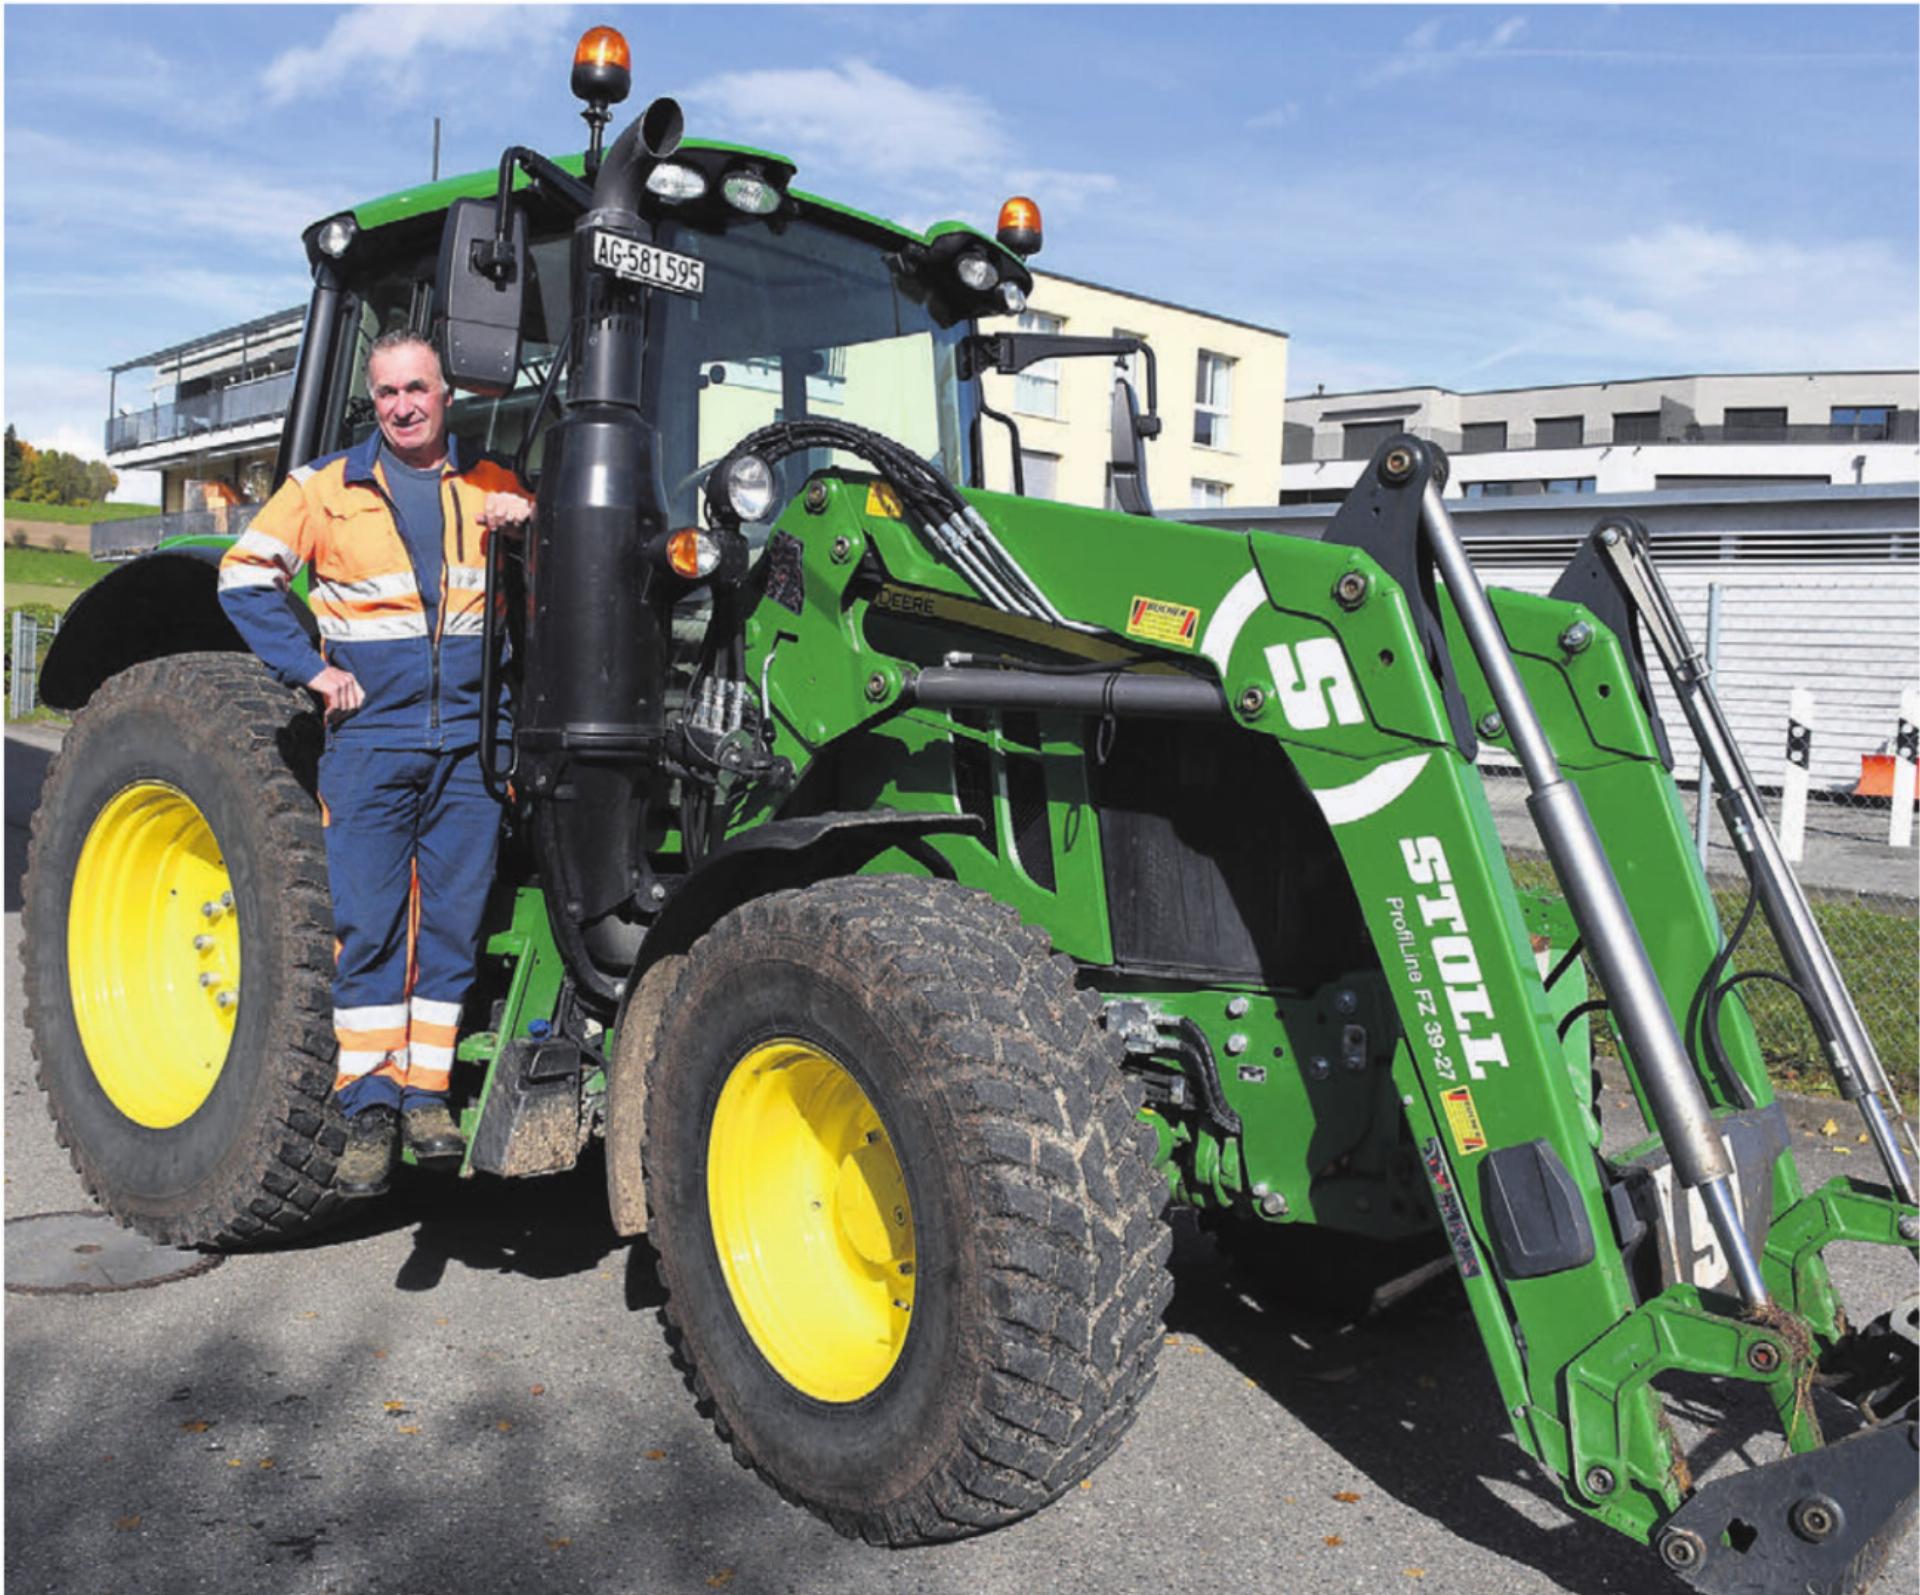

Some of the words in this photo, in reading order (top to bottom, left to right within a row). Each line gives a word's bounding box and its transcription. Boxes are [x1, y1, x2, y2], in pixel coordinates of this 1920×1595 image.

[1263, 636, 1366, 731] S
[1399, 836, 1510, 1080] STOLL
[1414, 988, 1438, 1027] FZ
[1424, 1020, 1458, 1082] 39-27
